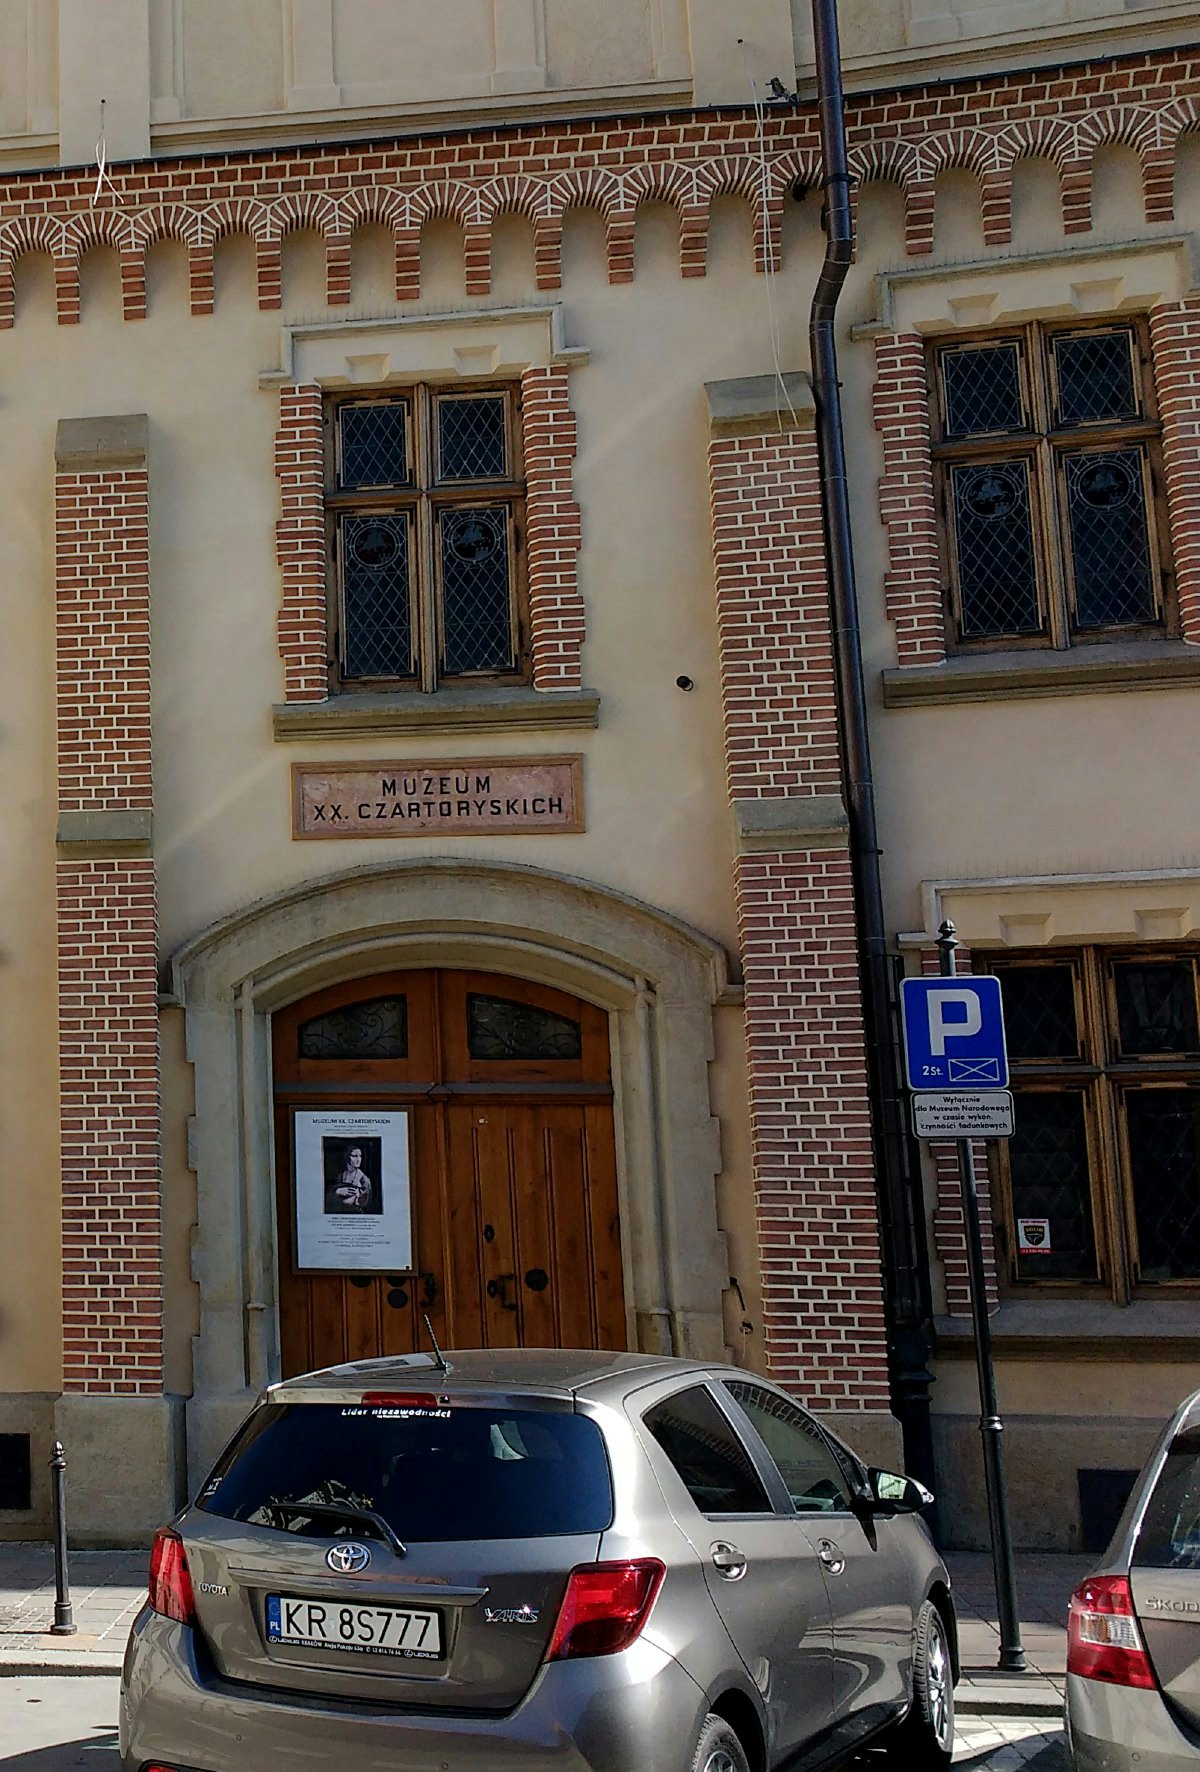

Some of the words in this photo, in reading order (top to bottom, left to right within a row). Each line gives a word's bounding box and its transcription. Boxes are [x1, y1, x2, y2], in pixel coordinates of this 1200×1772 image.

[382, 775, 490, 796] MUZEUM
[314, 804, 349, 821] XX.
[358, 797, 563, 818] CZARTORYSKICH
[926, 988, 982, 1056] P
[961, 1104, 1010, 1113] Narodowego
[341, 1408, 368, 1416] Lider
[199, 1582, 228, 1596] TOYOTA
[269, 1621, 280, 1630] PL
[285, 1602, 327, 1638] KR
[339, 1607, 432, 1648] 8S777
